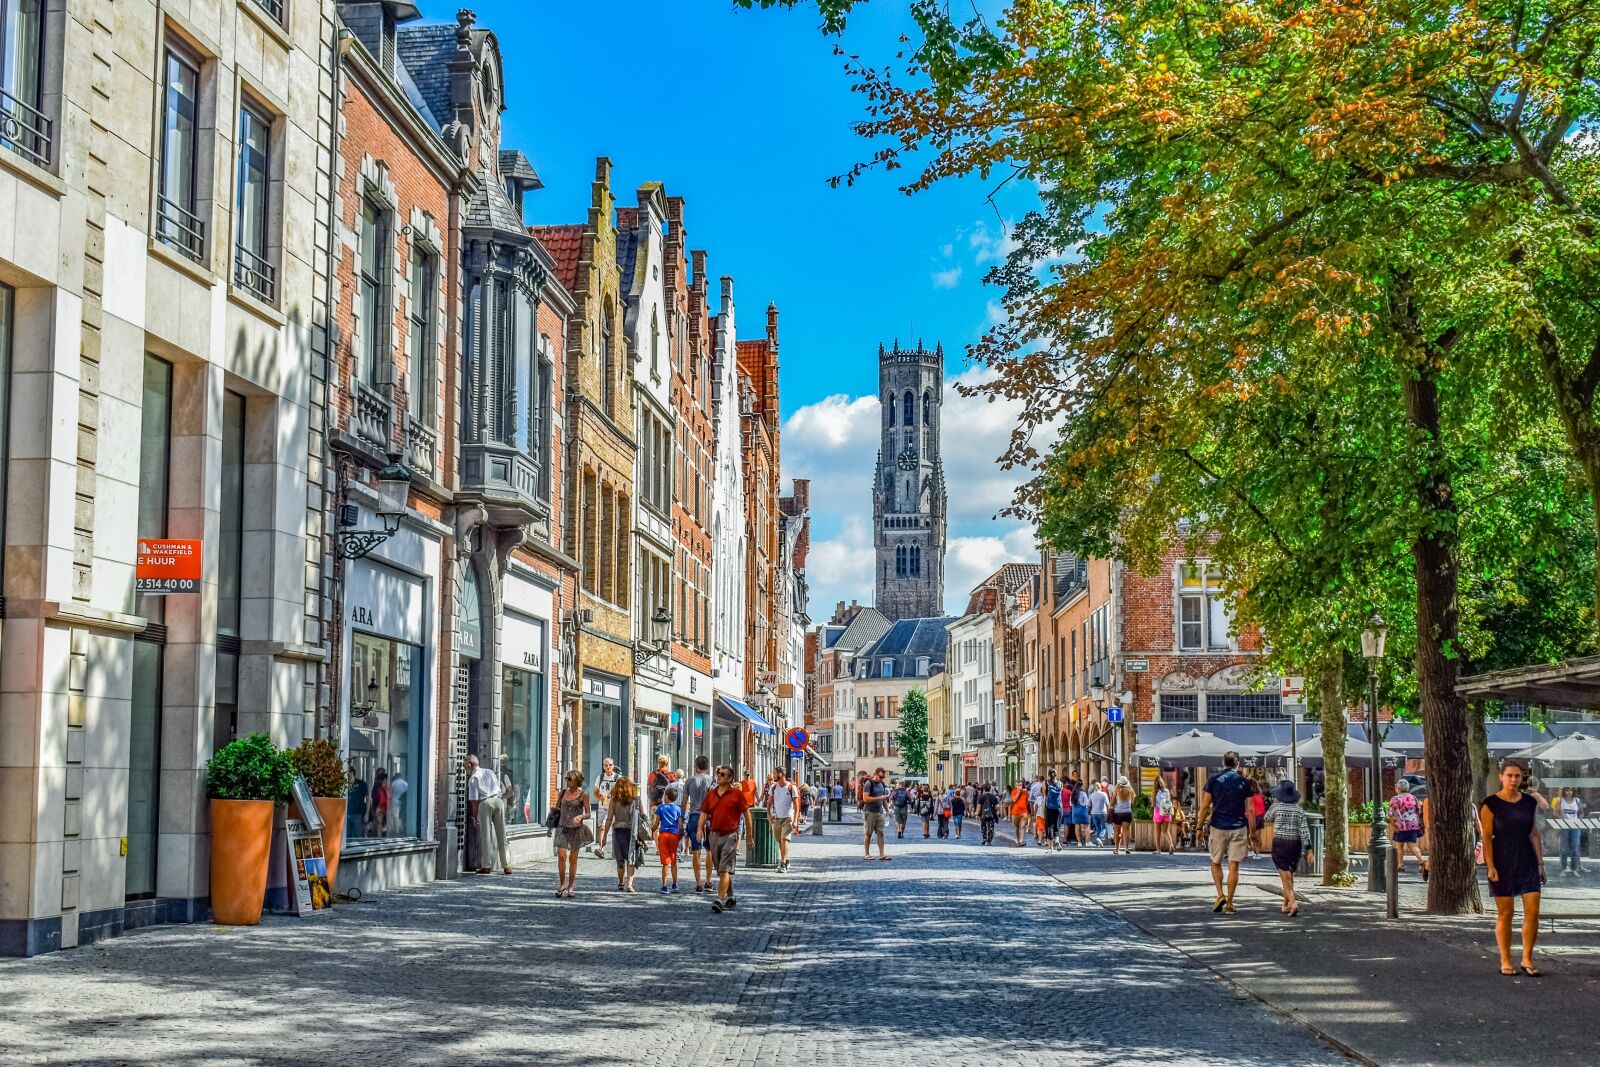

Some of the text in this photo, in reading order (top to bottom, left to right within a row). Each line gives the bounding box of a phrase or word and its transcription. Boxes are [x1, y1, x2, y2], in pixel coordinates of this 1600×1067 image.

[138, 557, 176, 565] E HUUR
[136, 579, 193, 589] 2 514 40 00
[351, 605, 374, 626] ARA
[459, 630, 474, 648] ARA
[523, 651, 539, 667] ZARA
